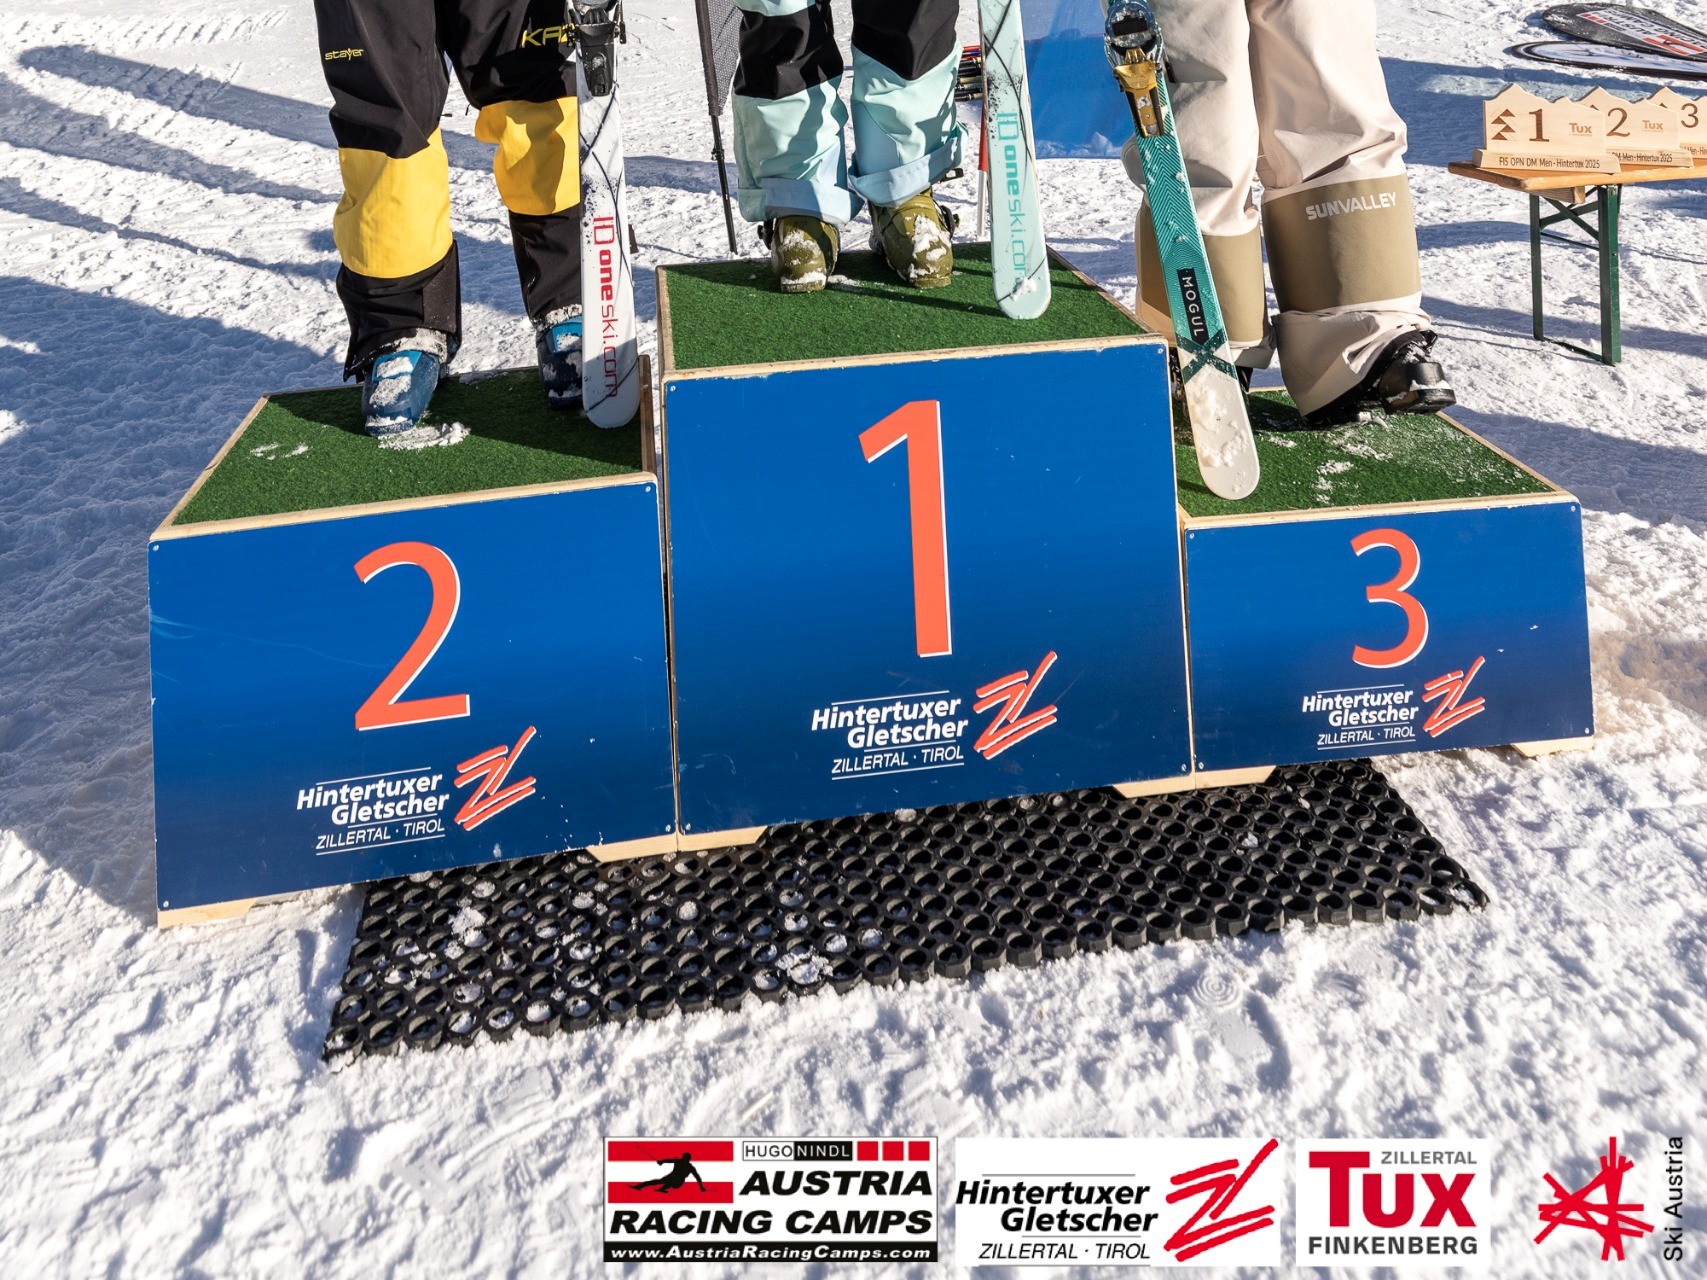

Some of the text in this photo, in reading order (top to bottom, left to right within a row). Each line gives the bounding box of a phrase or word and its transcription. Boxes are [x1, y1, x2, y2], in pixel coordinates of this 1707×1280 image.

[325, 47, 364, 61] stayer
[1528, 108, 1550, 142] 1
[1568, 122, 1592, 134] Tux
[1606, 107, 1631, 137] 2
[1642, 120, 1664, 131] Tux
[1680, 102, 1699, 128] 3
[1499, 157, 1509, 167] FIS
[1511, 157, 1525, 167] OPN
[1526, 158, 1538, 168] DM
[1585, 159, 1601, 169] 2025
[1659, 153, 1673, 163] 2025
[1305, 191, 1397, 220] SUNVALLEY
[1182, 276, 1205, 337] MOGUL
[858, 399, 952, 658] 1
[1350, 528, 1429, 669] 3
[354, 541, 471, 731] 2
[811, 698, 961, 731] Hintertuxer
[1302, 689, 1413, 713] Hintertuxer
[1328, 706, 1419, 727] Gletscher
[847, 718, 968, 749] Gletscher
[1317, 725, 1416, 746] ZILLERTAL TIROL
[832, 745, 965, 774] ZILLERTAL TIROL
[296, 773, 443, 810] Hintertuxer
[331, 793, 450, 826] Gletscher
[316, 818, 446, 850] ZILLERTAL TIROL
